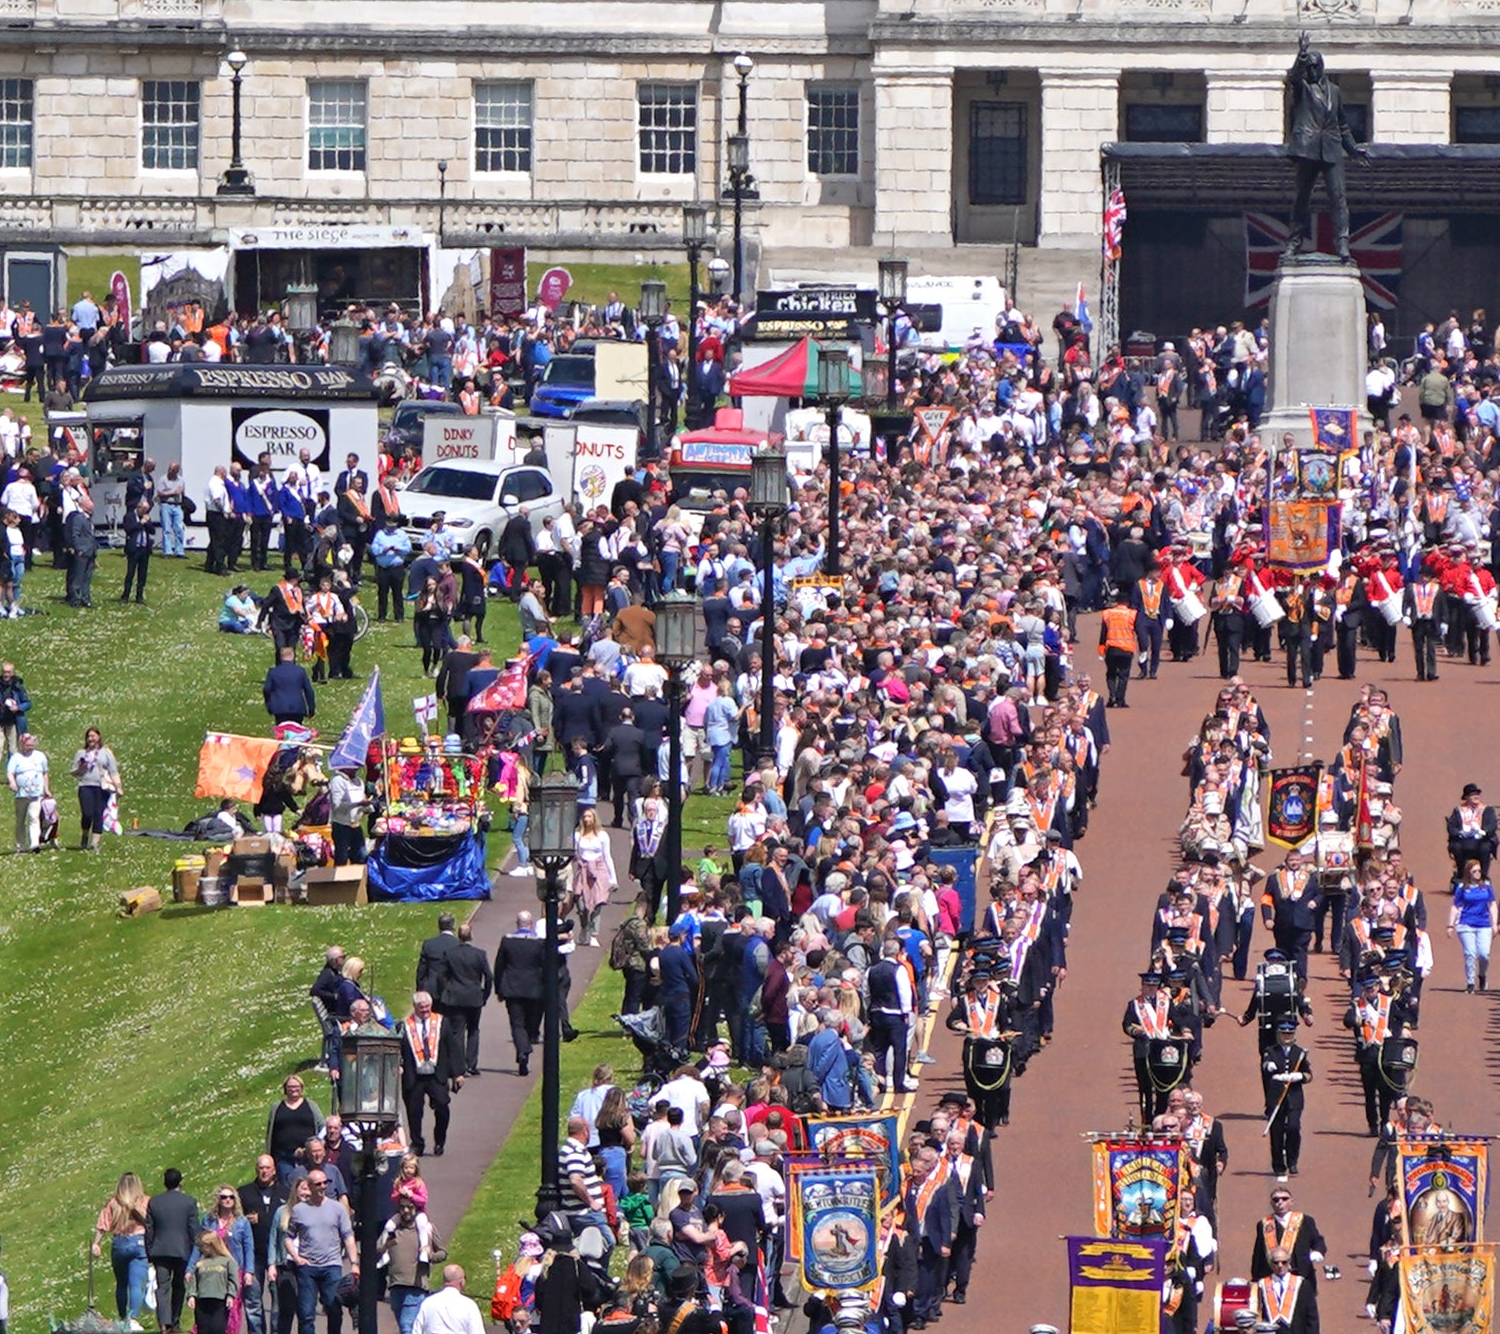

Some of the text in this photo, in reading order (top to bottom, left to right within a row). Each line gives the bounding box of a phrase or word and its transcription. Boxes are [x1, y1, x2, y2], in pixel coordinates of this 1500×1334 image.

[193, 369, 313, 389] ESPRESSO
[314, 370, 355, 388] BAR
[924, 412, 945, 420] GIVE
[244, 425, 317, 440] ESPRESSO
[443, 427, 475, 442] DINKY
[266, 440, 297, 457] BAR
[437, 444, 479, 458] DONUTS
